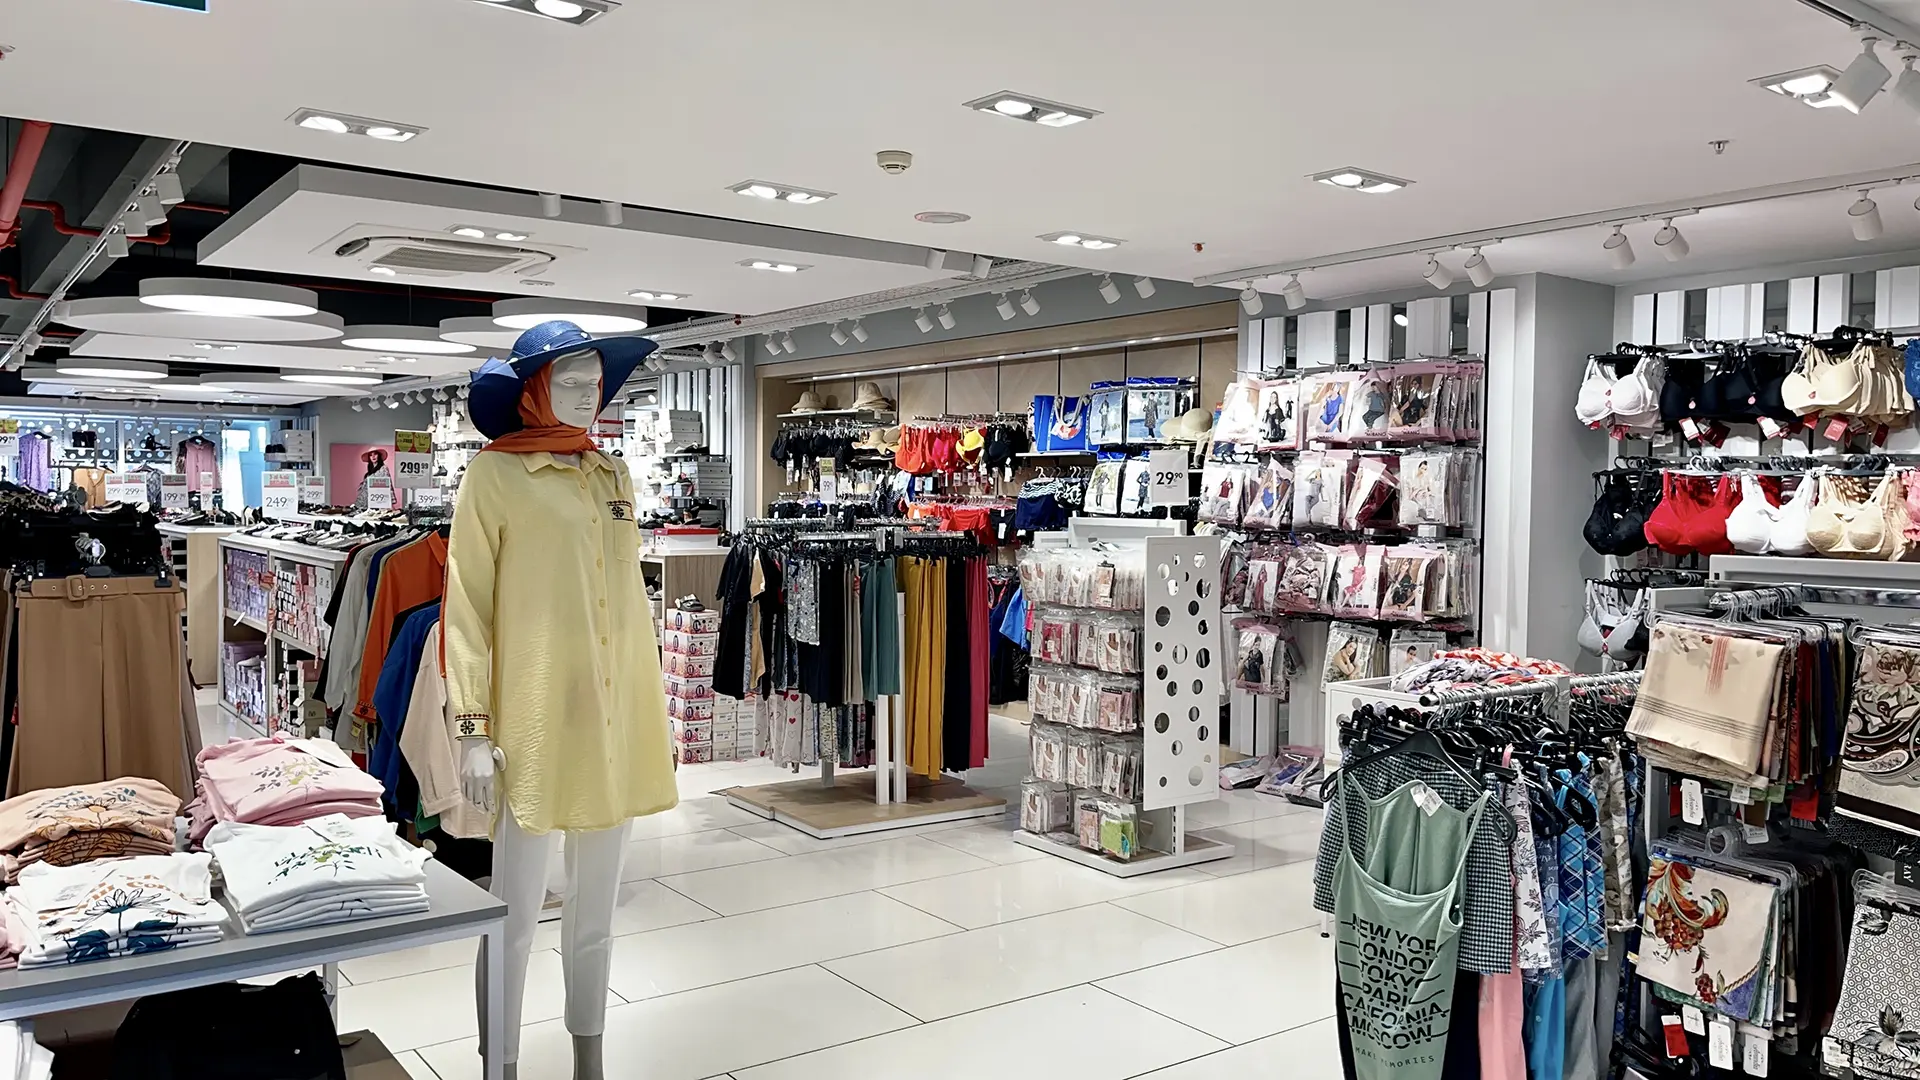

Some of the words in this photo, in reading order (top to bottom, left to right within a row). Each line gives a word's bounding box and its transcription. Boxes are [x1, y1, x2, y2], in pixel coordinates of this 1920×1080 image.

[1352, 912, 1391, 944] NEW
[1395, 929, 1437, 957] YOR
[1358, 936, 1436, 975] LONDO
[1361, 981, 1413, 1012] PARI
